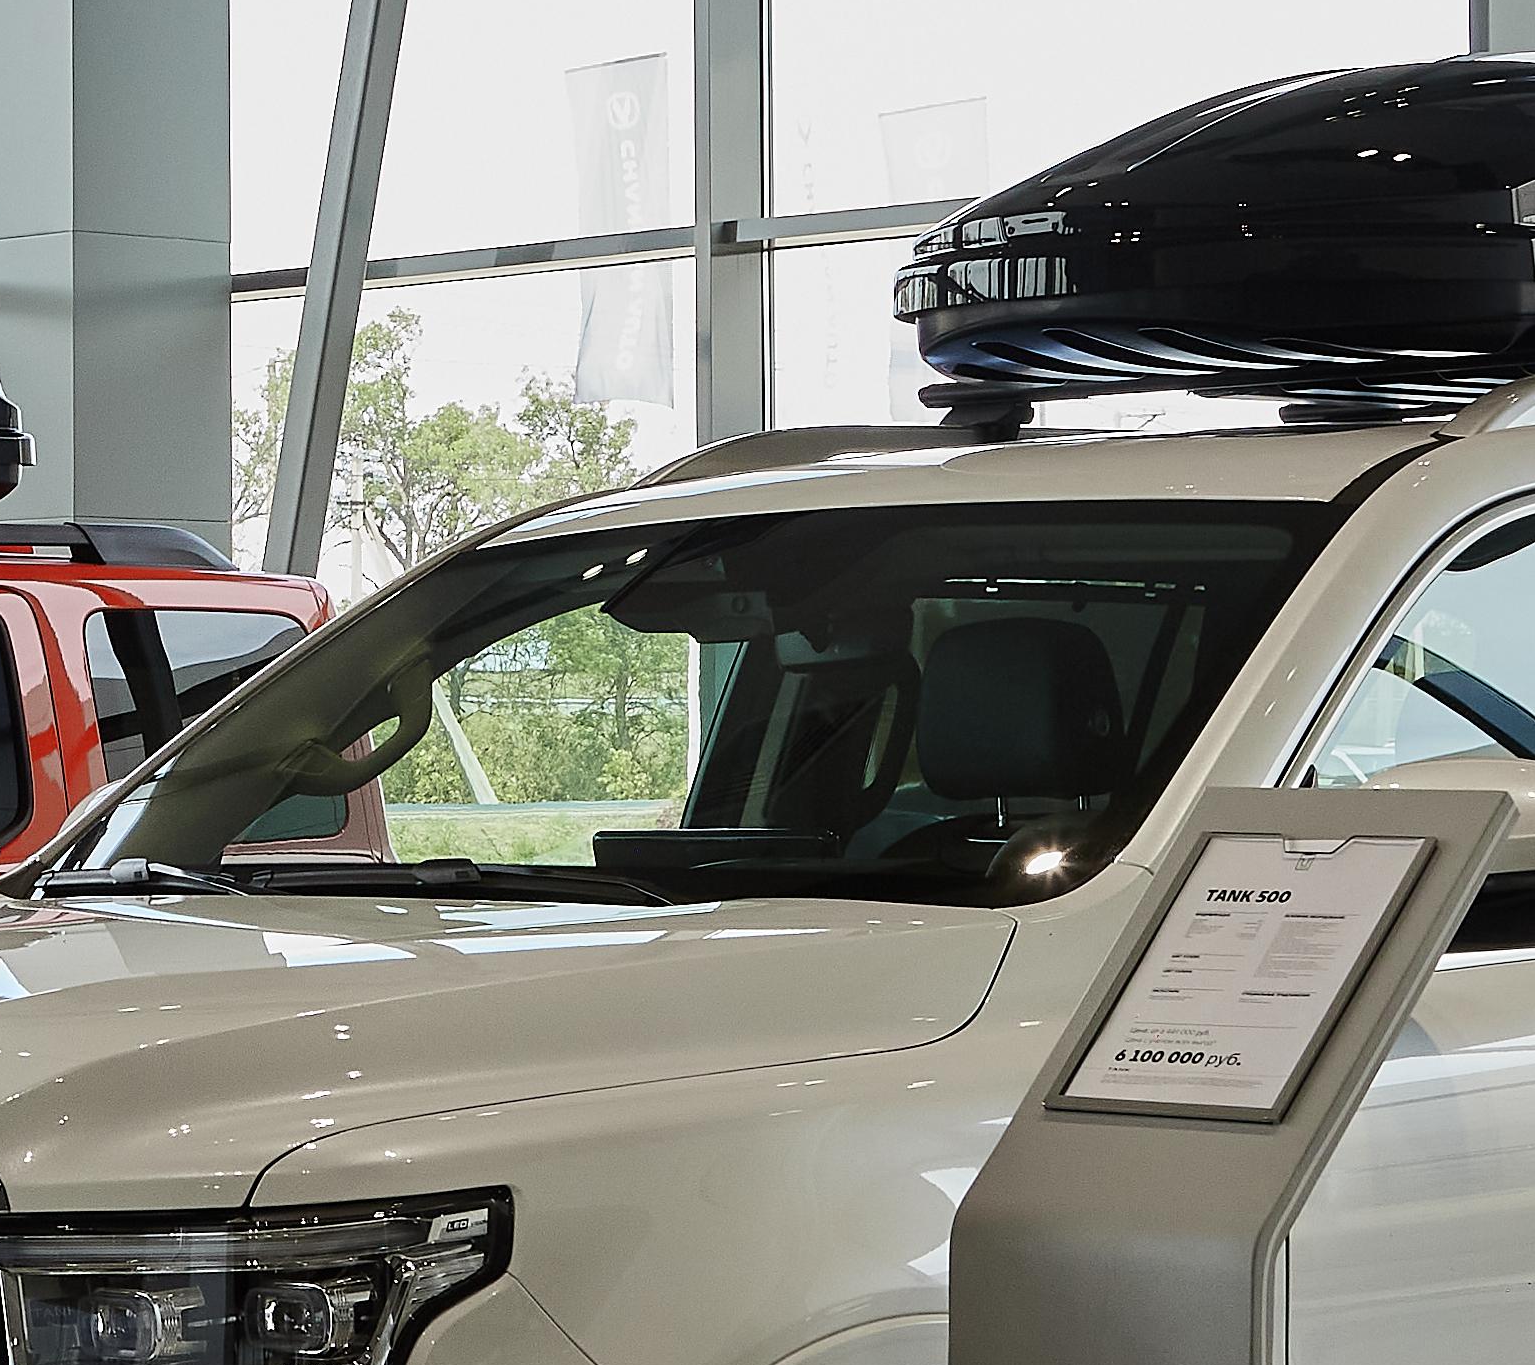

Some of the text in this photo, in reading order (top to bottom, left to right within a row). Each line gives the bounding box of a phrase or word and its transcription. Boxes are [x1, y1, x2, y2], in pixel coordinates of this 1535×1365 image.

[1205, 889, 1292, 904] TANK 500
[1114, 1049, 1242, 1068] 6 100 000 руб.
